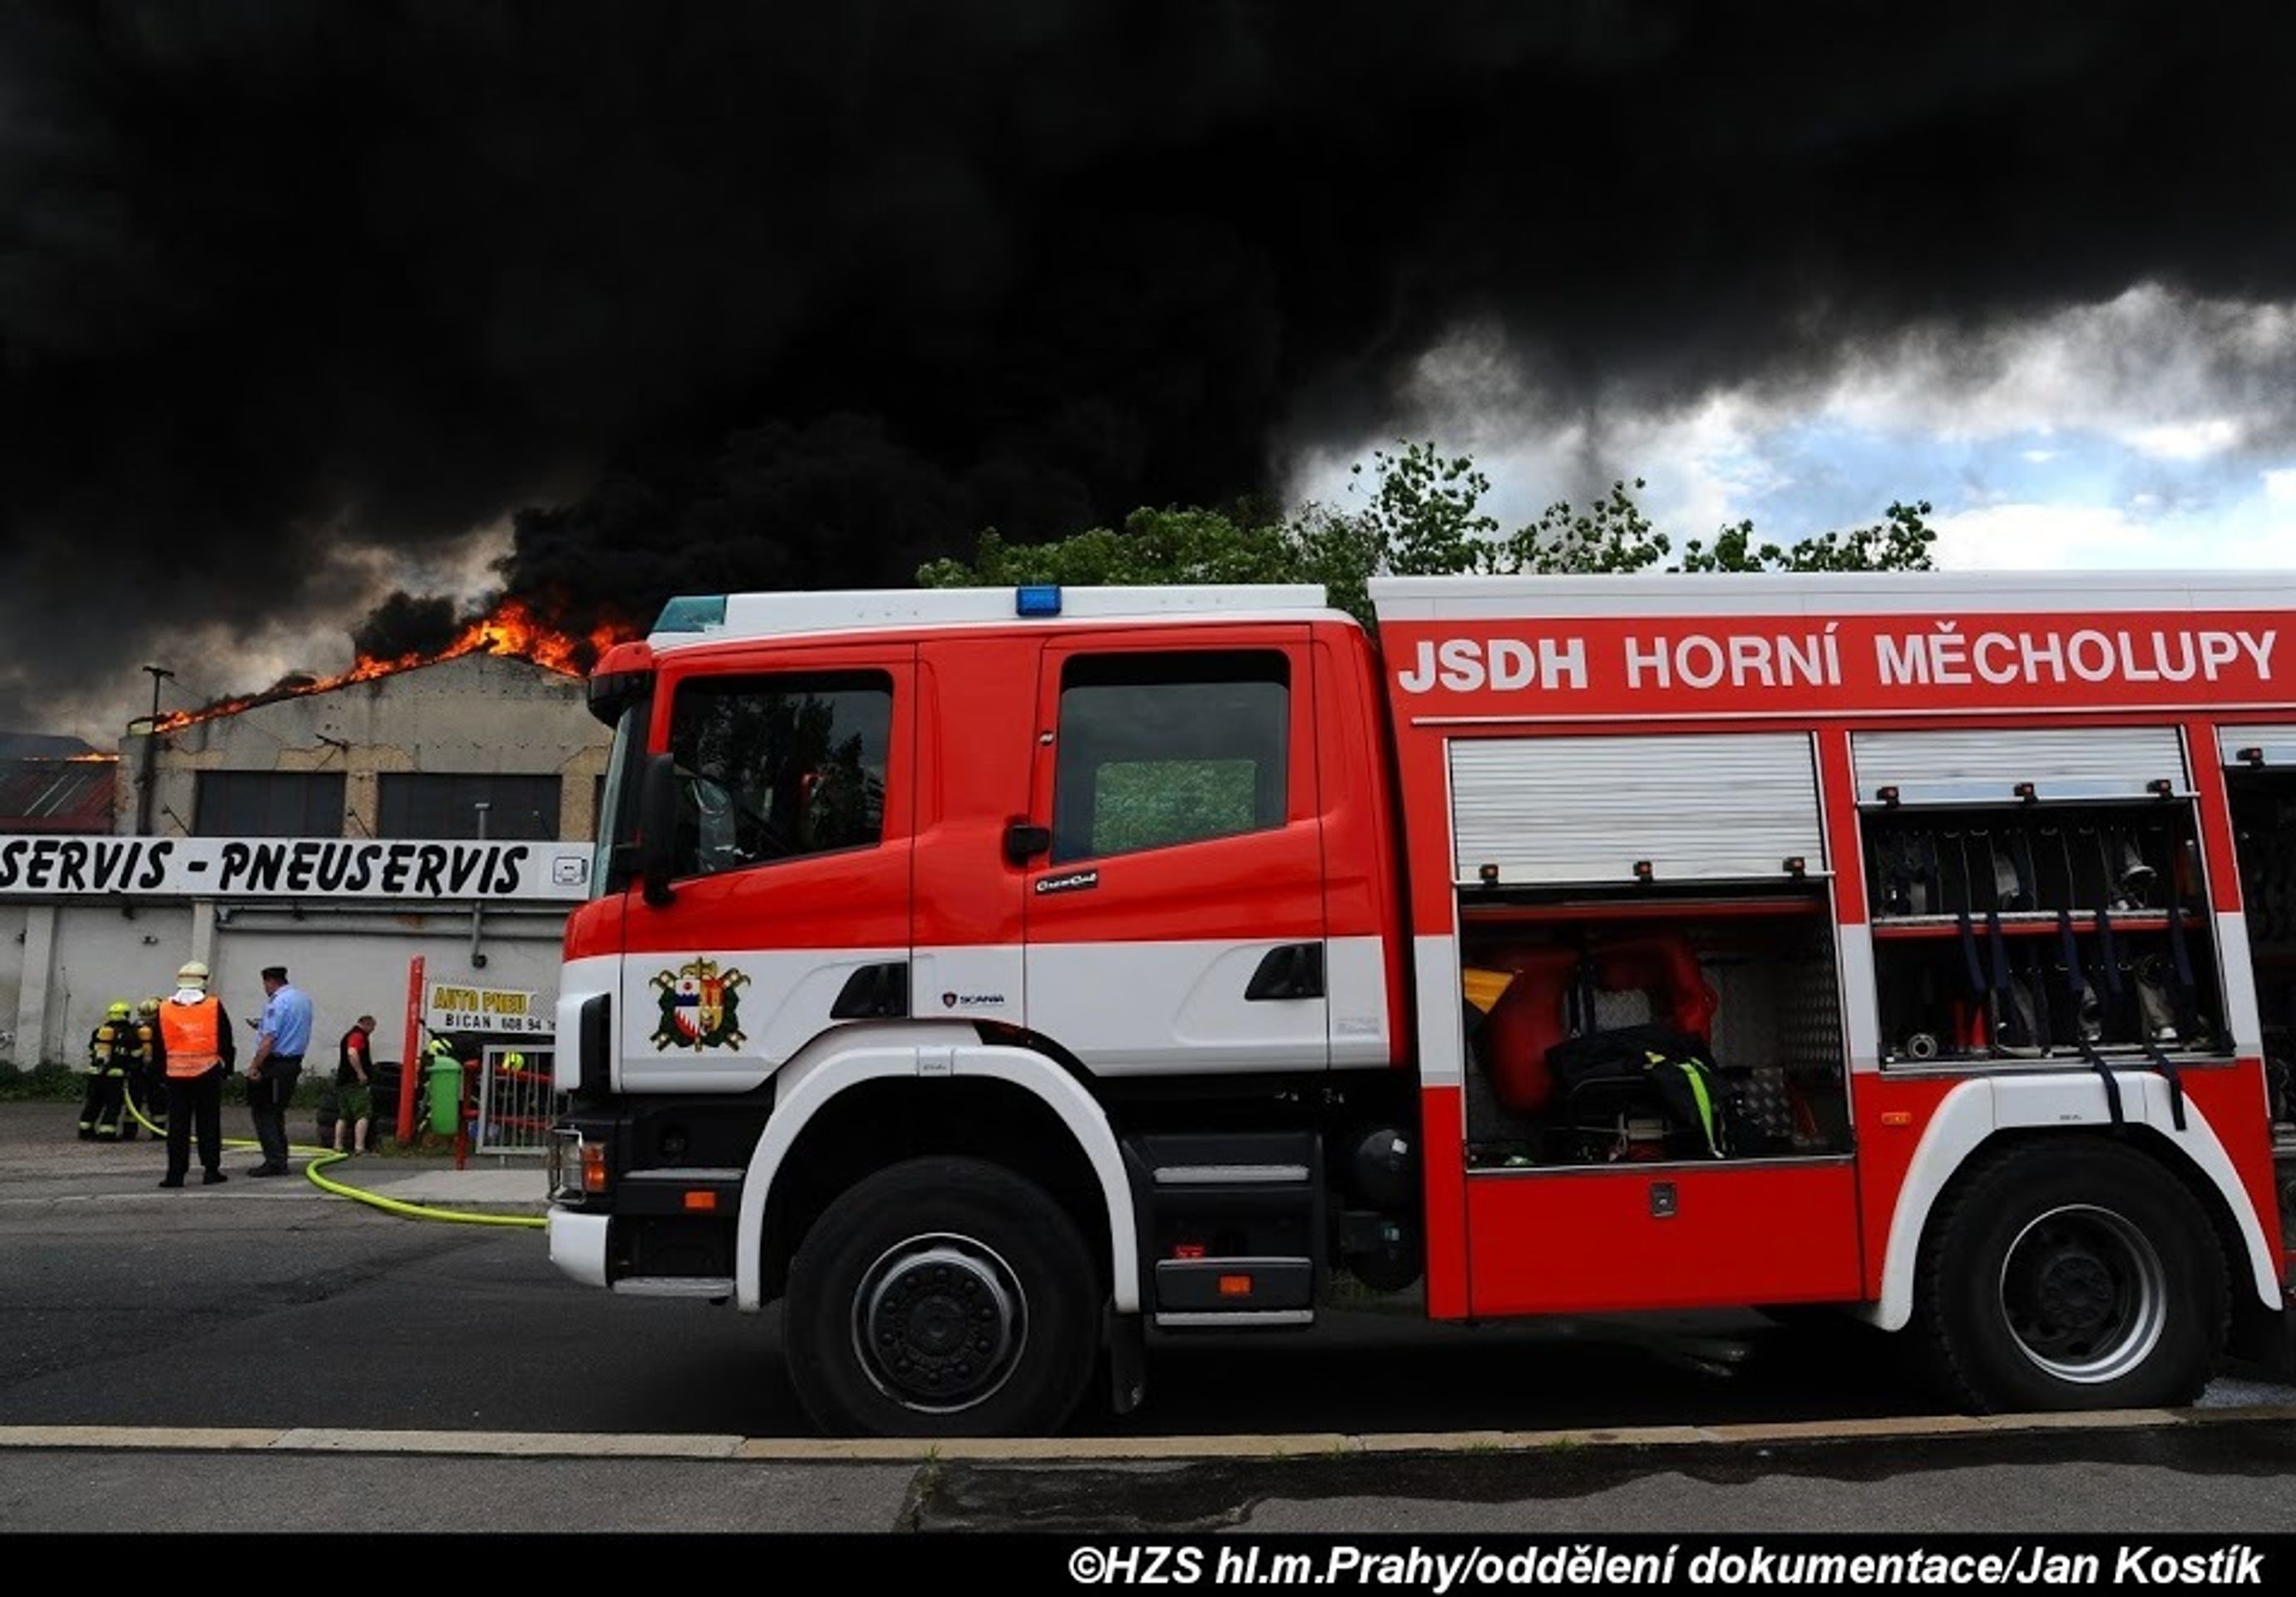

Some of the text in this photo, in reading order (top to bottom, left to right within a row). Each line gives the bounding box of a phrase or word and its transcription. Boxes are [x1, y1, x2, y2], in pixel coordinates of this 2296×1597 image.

[1398, 621, 2277, 694] JSDH HORNÍ MĚCHOLUPY
[0, 839, 174, 892] SERVIS
[219, 842, 529, 896] PNEUSERVIS
[433, 986, 527, 1015] AUTO PNEU
[446, 1013, 491, 1029] BICAN
